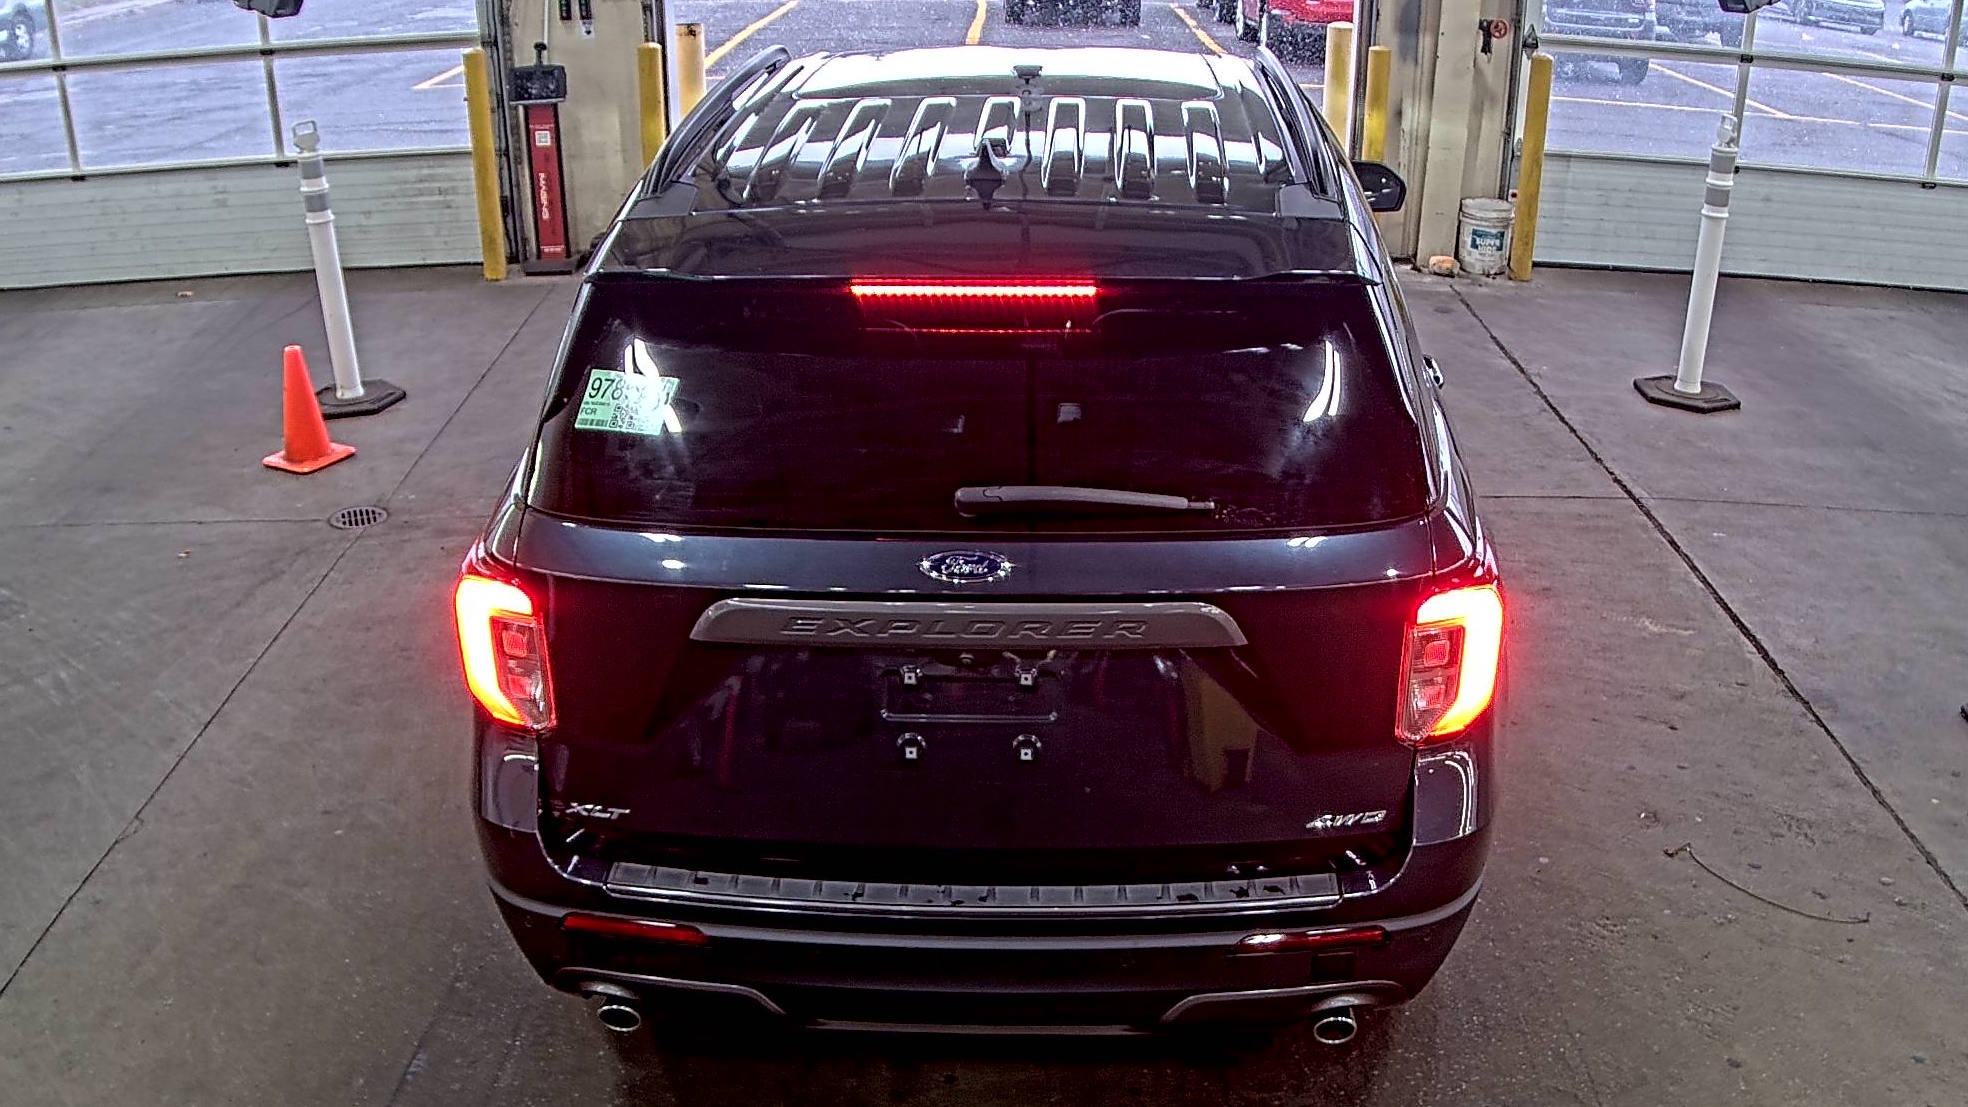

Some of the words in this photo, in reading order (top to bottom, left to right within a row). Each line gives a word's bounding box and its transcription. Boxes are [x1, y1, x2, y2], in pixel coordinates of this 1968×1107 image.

[941, 556, 989, 575] Ford
[779, 616, 1148, 640] EXPLORER
[566, 802, 631, 820] XLT
[1305, 810, 1387, 829] 4WD
